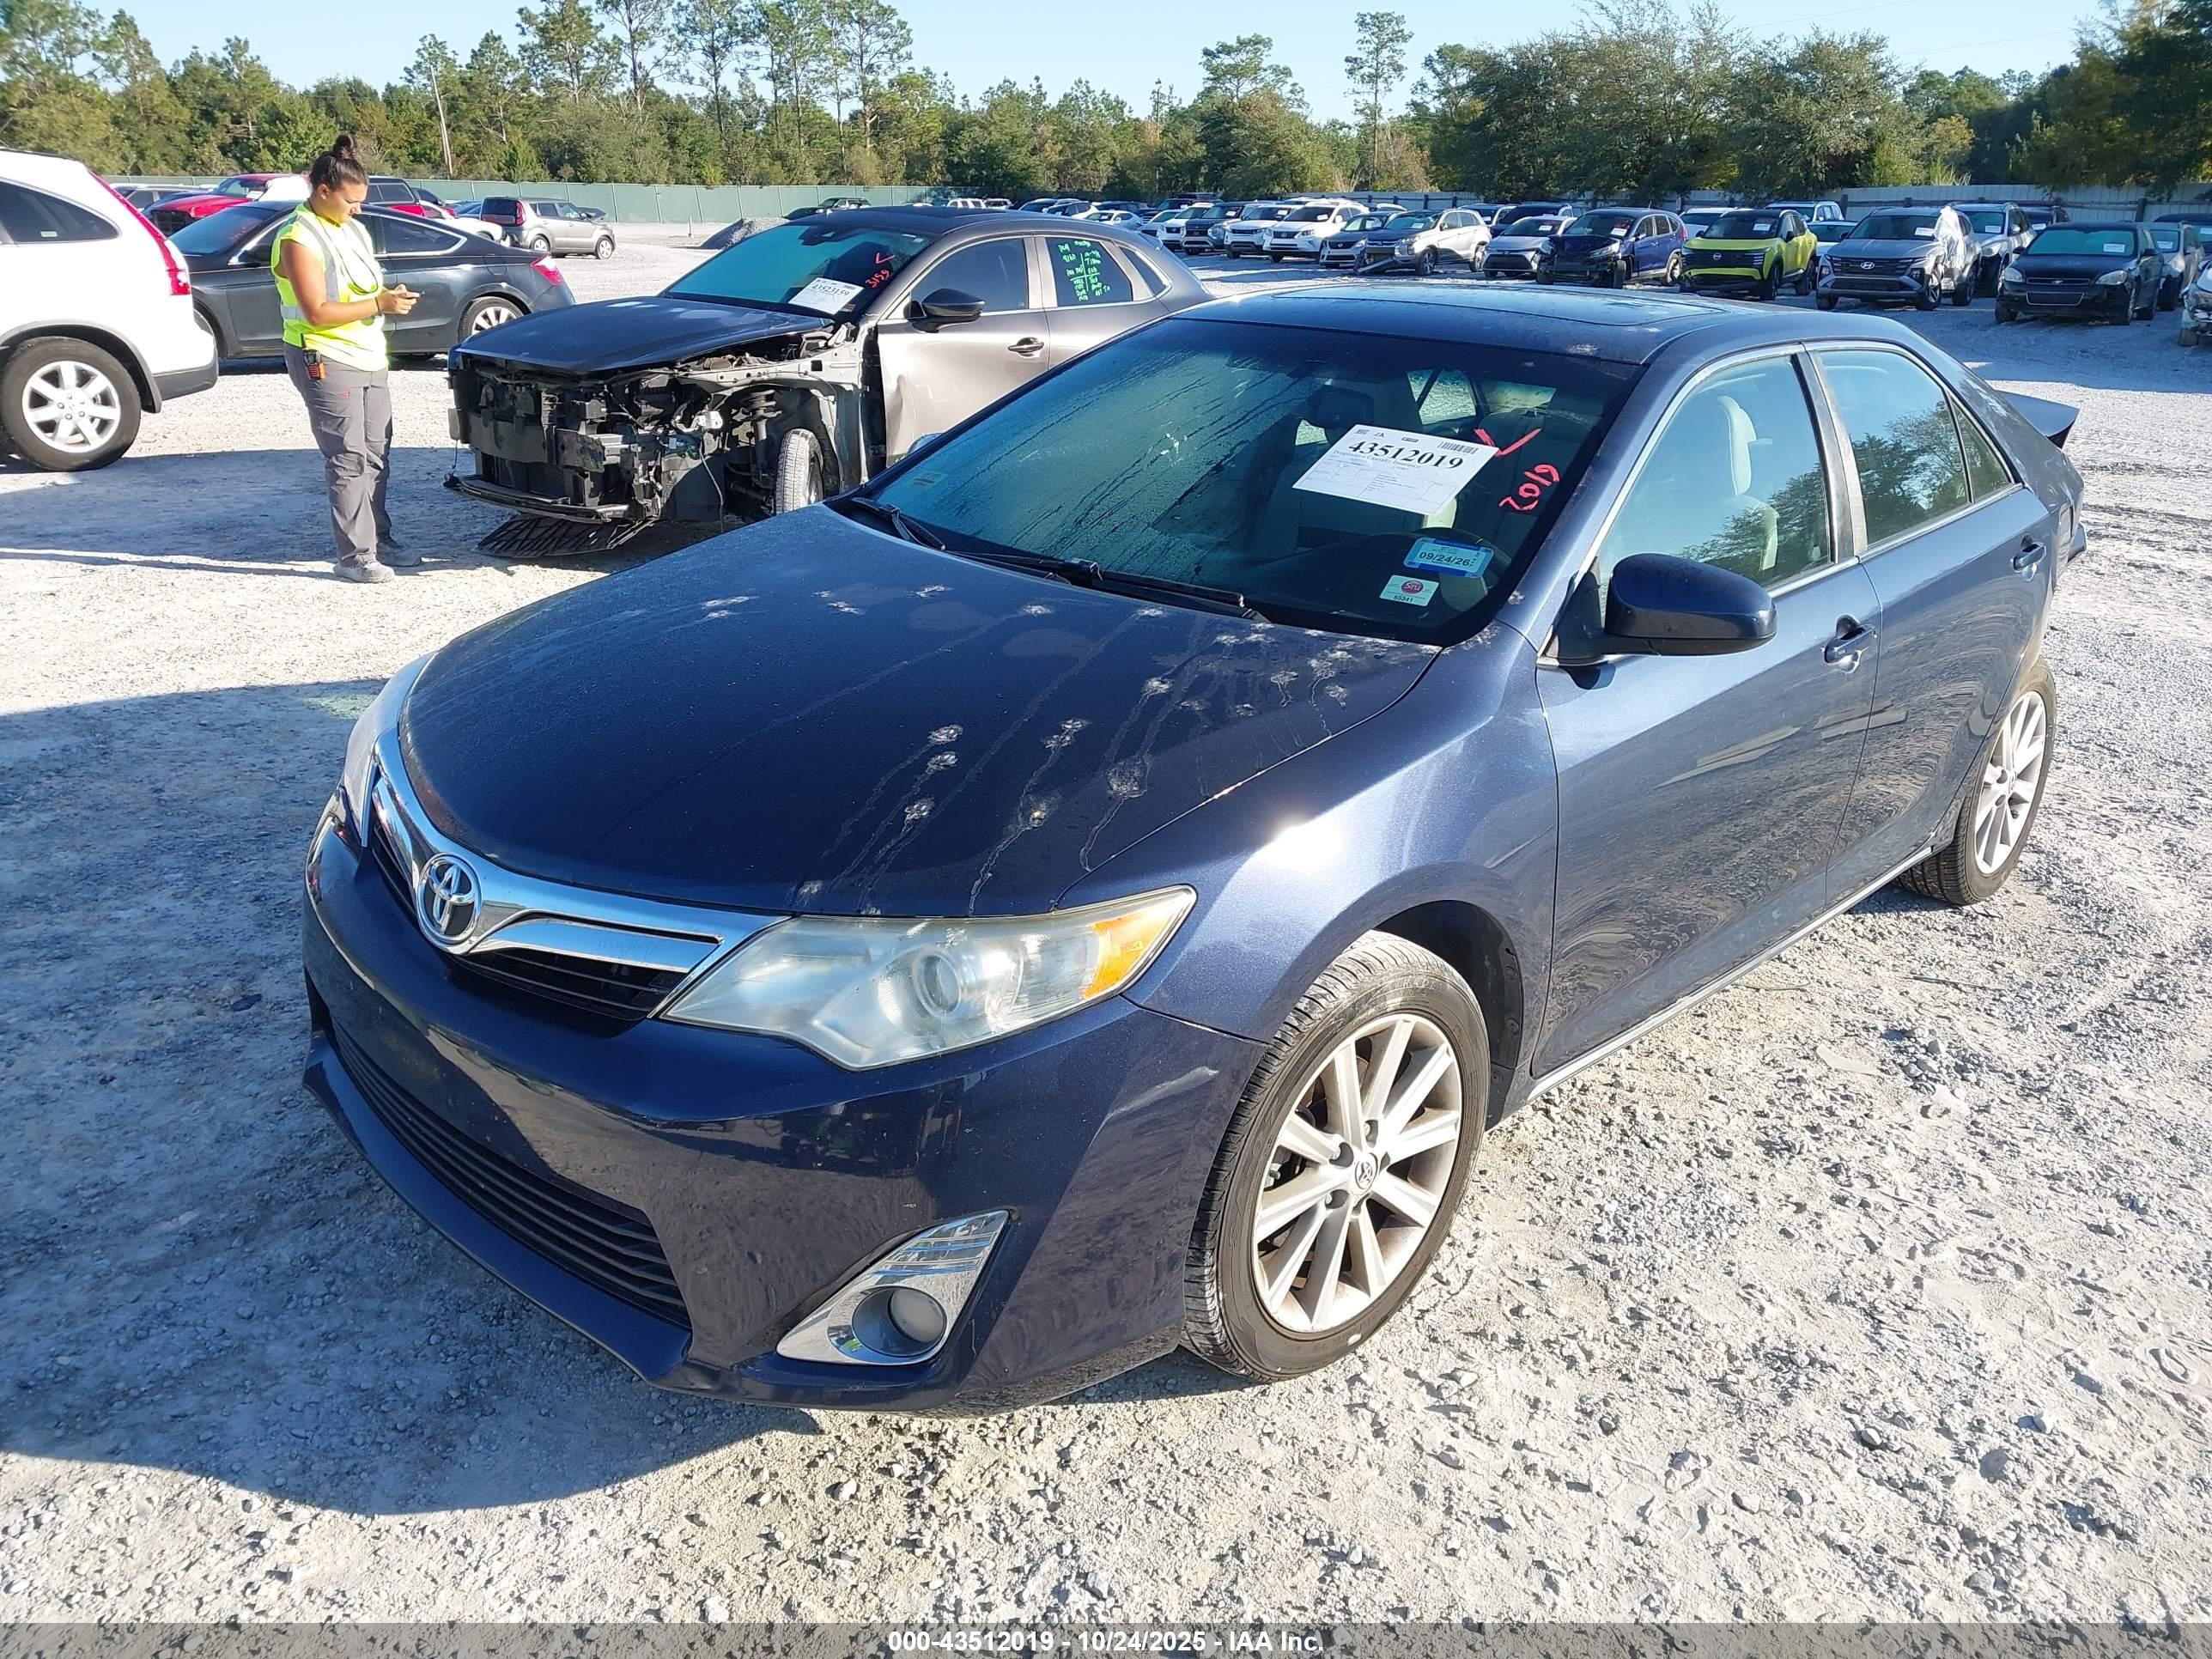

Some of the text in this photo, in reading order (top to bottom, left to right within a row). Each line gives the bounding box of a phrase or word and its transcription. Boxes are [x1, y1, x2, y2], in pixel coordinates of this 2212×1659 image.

[1347, 440, 1464, 470] 43512019
[1498, 464, 1560, 511] 2019
[1419, 550, 1471, 567] 09/24/26
